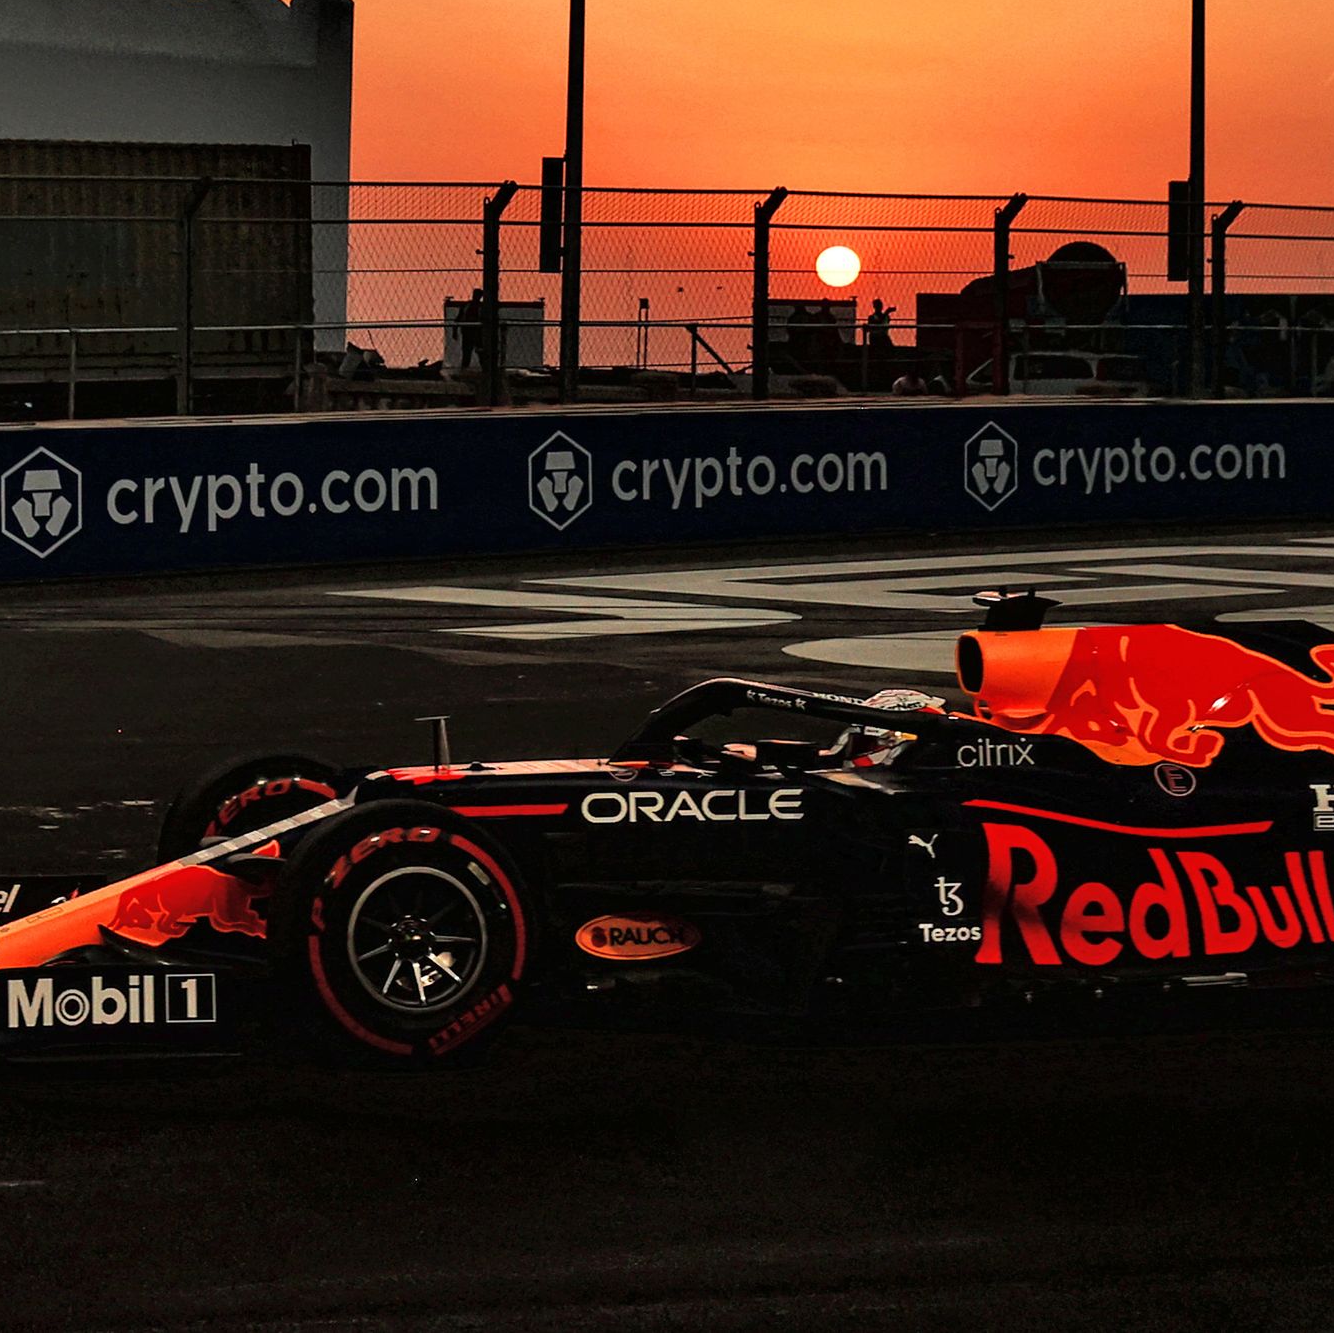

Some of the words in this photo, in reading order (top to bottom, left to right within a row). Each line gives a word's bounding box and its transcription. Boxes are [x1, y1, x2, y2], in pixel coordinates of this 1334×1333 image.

[612, 447, 887, 510] crypto.com
[1032, 436, 1286, 494] crypto.com
[107, 463, 437, 533] crypto.com
[956, 737, 1035, 767] citrix
[581, 788, 805, 824] ORACLE
[918, 923, 982, 943] Tezos
[7, 973, 155, 1029] Mobil
[180, 978, 199, 1019] 1
